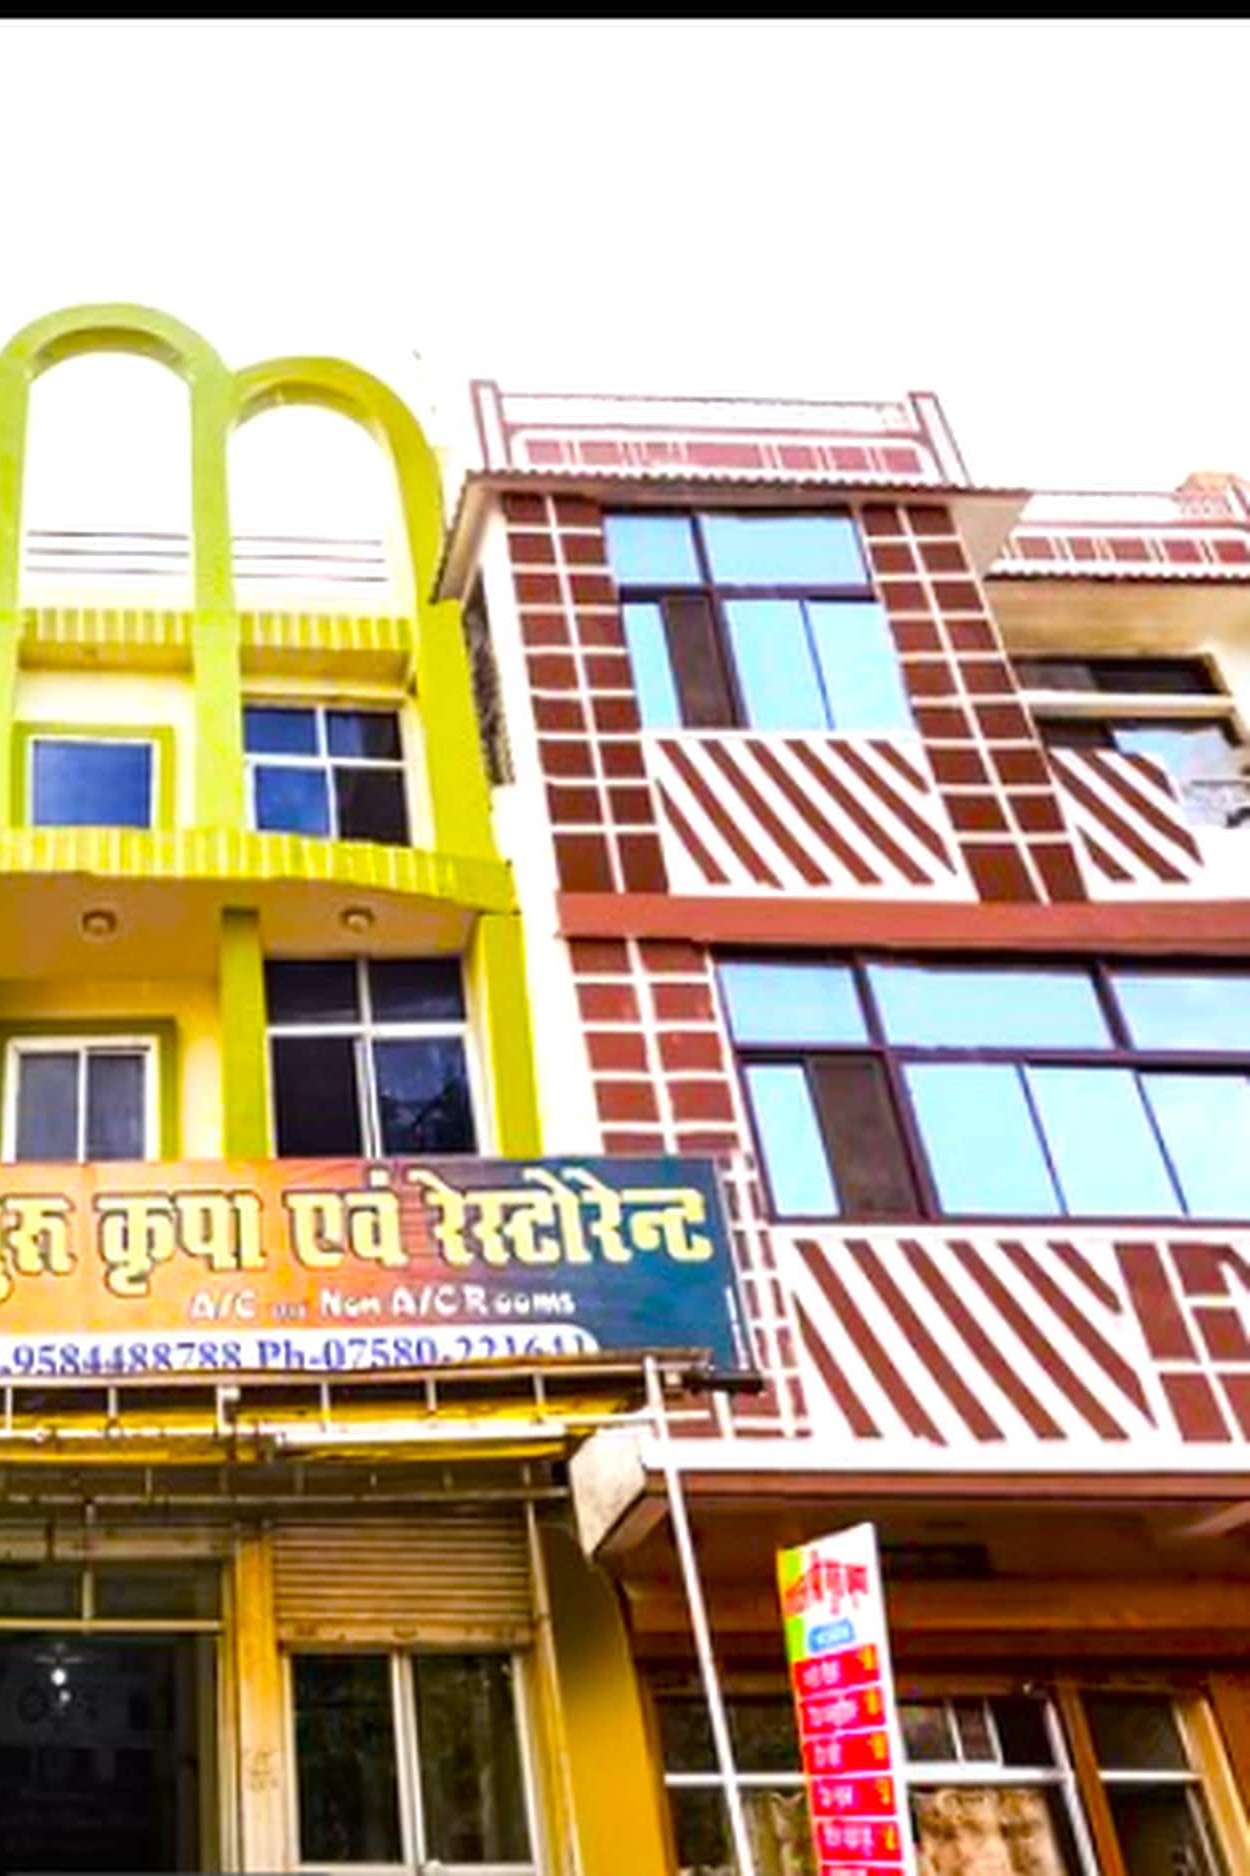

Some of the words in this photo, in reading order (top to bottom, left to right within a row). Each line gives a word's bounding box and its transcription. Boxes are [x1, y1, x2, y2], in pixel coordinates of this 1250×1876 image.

[93, 1190, 266, 1297] कृपा
[284, 1165, 407, 1267] एवं
[405, 1166, 715, 1264] रेस्टोरेन्ट
[190, 1291, 256, 1319] A/C
[391, 1285, 455, 1316] A/C
